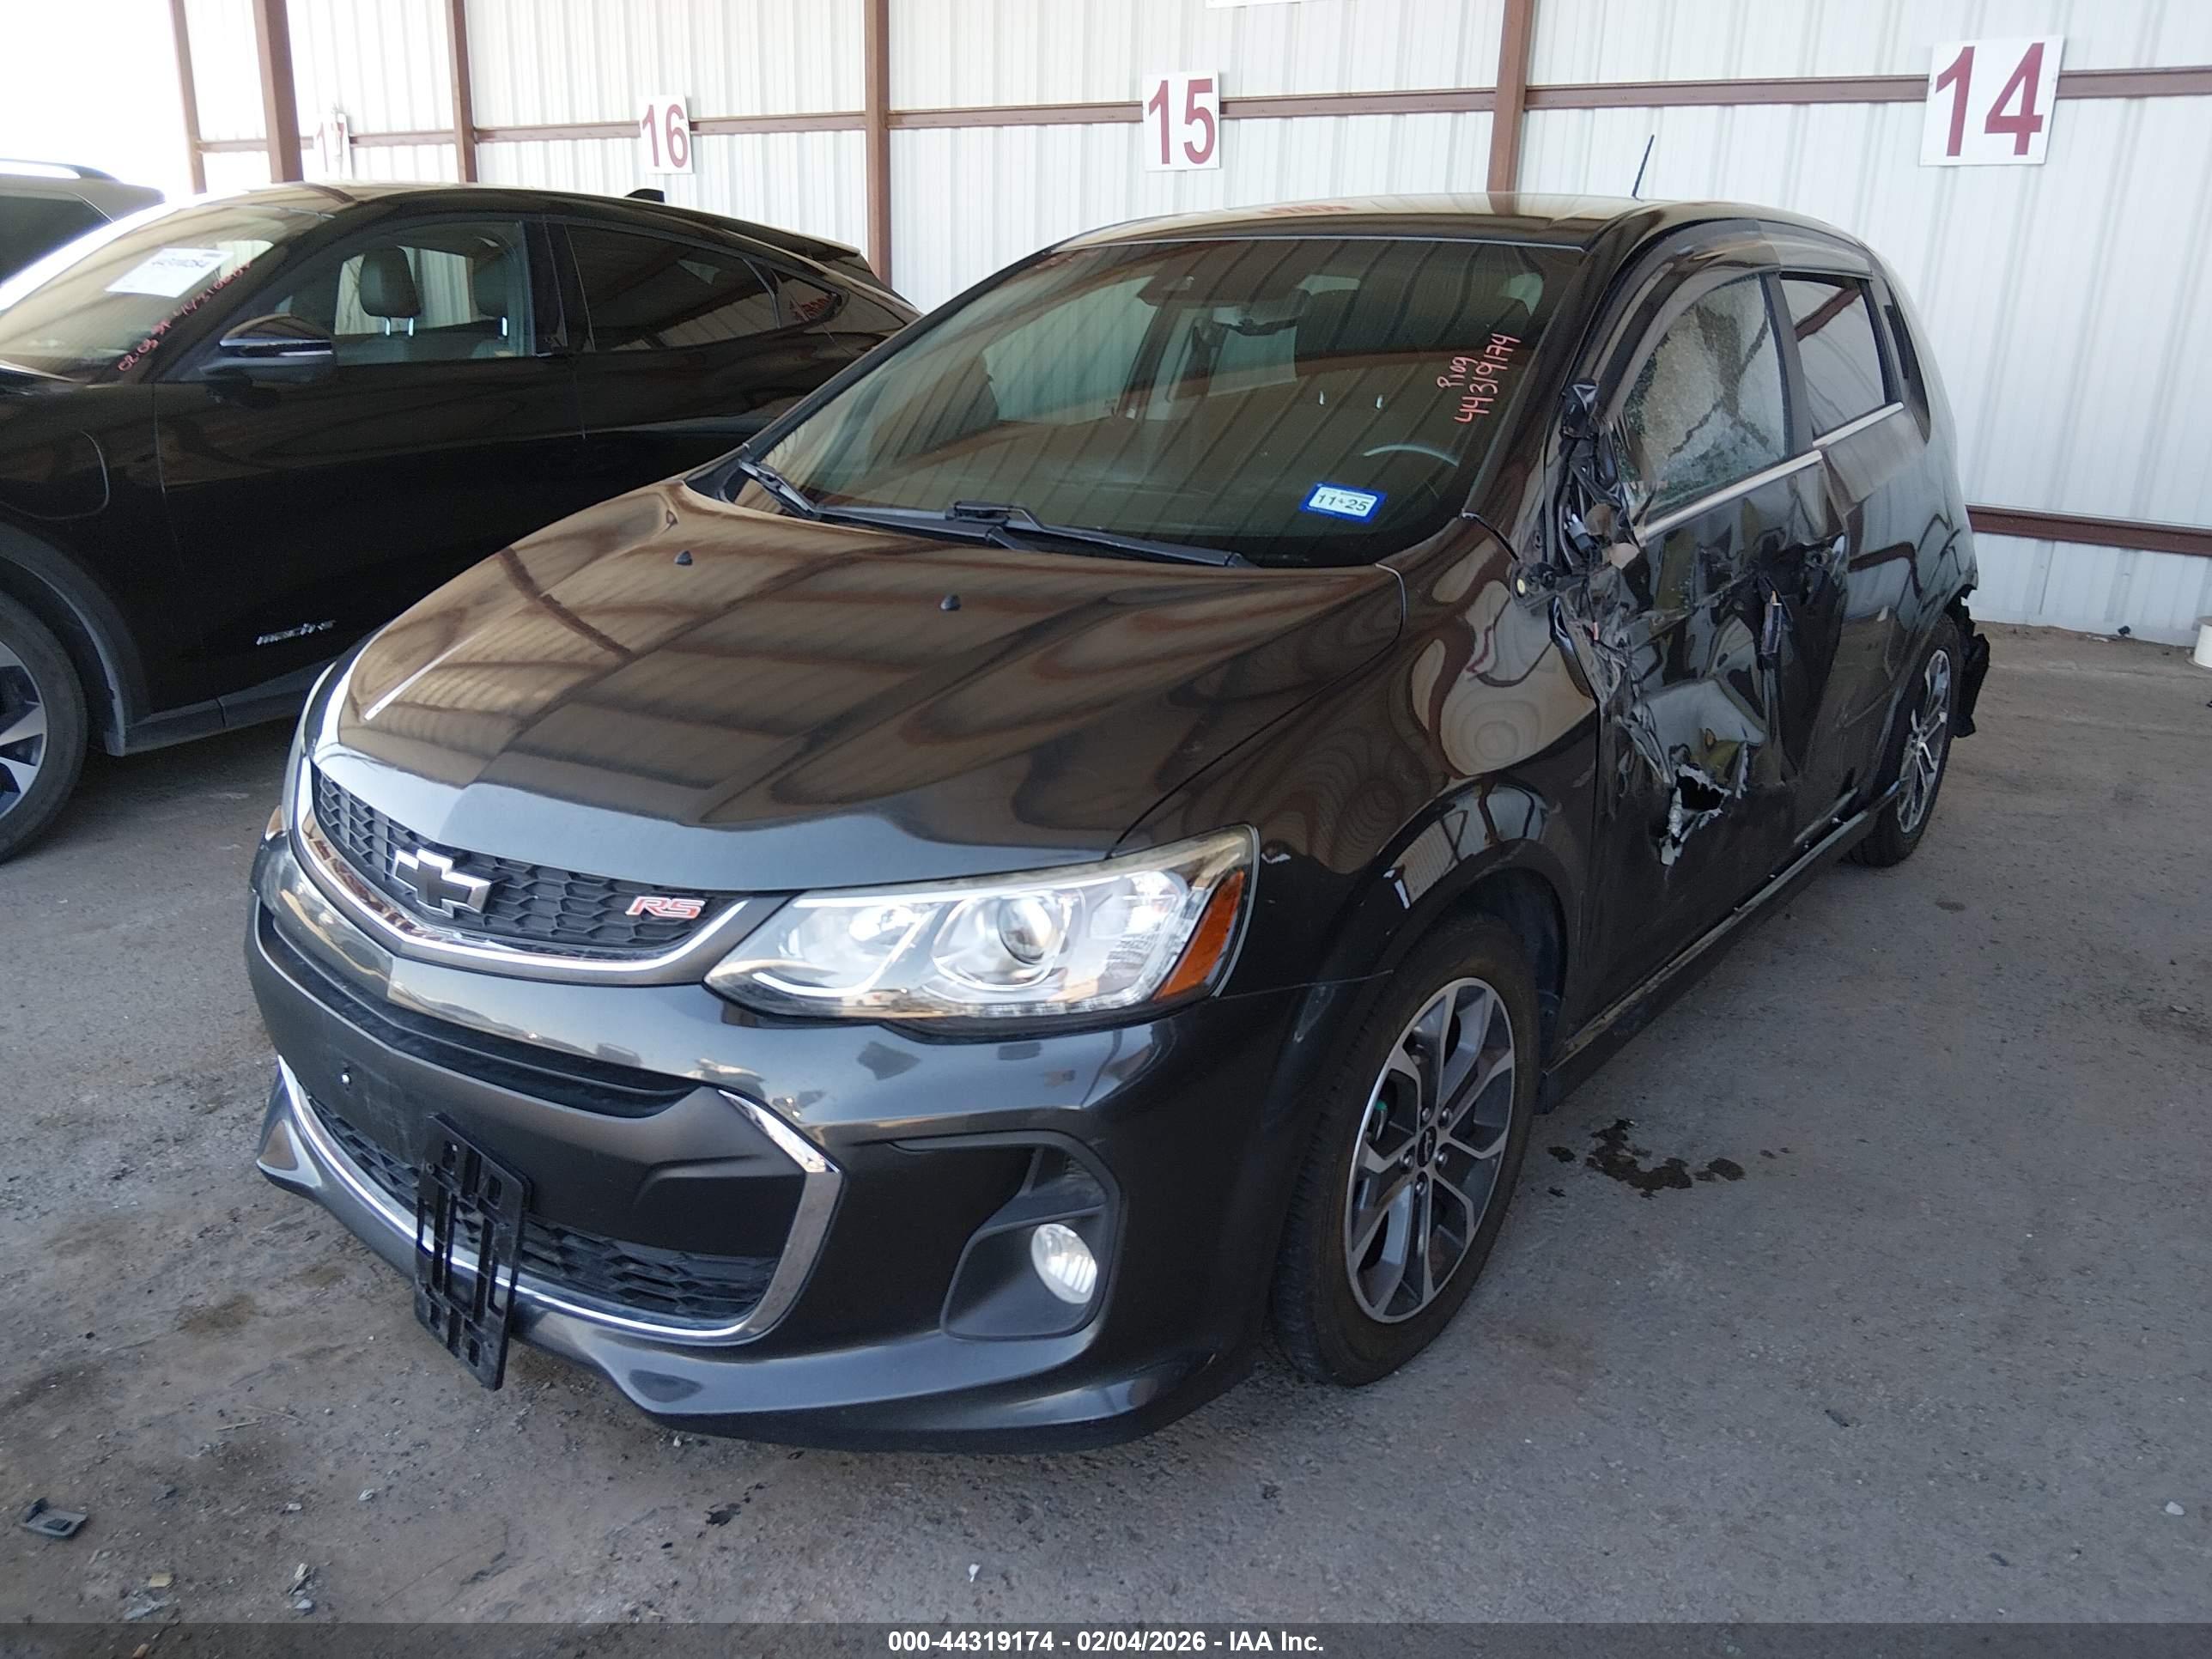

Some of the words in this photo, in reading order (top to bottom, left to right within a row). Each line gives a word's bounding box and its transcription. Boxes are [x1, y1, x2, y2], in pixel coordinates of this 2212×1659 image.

[642, 104, 689, 167] 16
[1148, 78, 1215, 164] 15
[1936, 42, 2045, 156] 14
[1454, 332, 1522, 422] 44319174
[625, 896, 706, 919] RS
